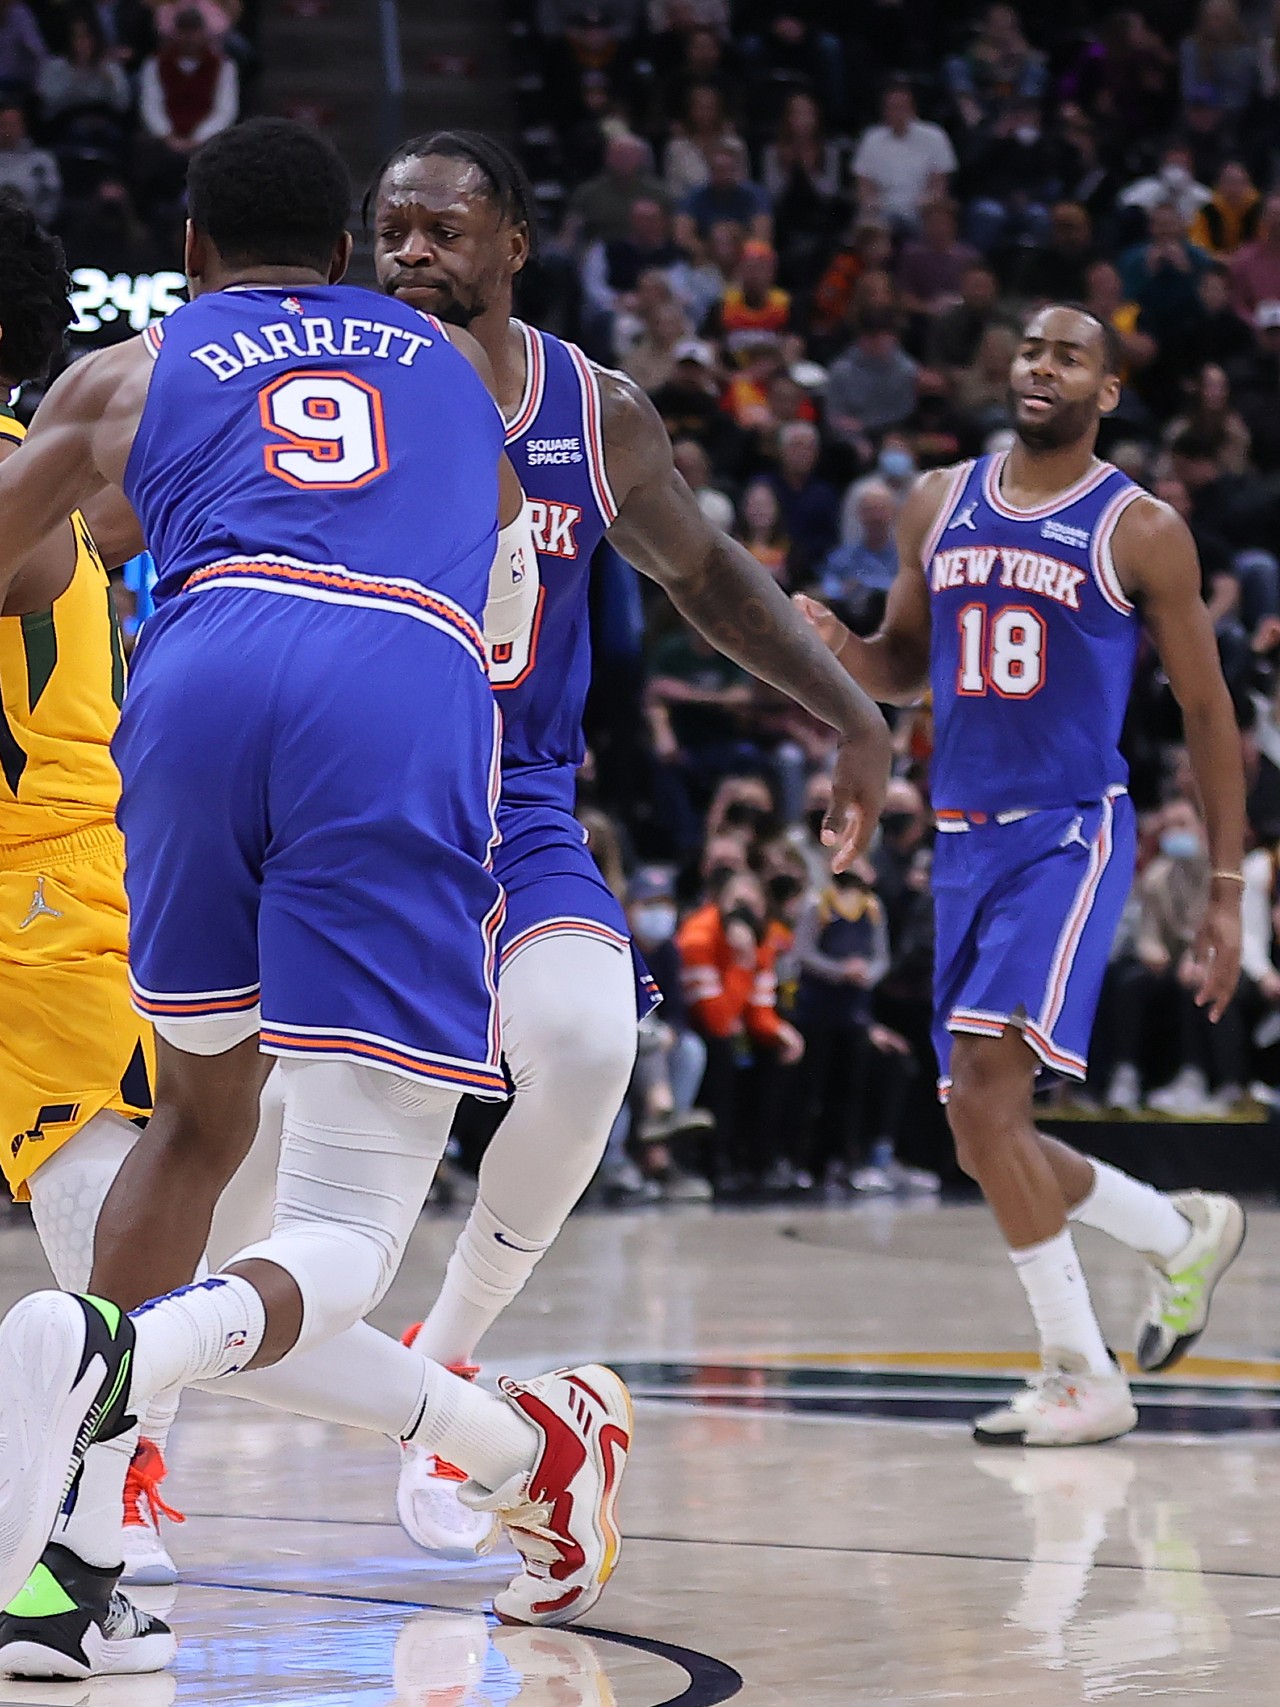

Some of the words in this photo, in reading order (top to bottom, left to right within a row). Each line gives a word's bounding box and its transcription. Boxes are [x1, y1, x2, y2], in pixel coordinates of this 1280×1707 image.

[190, 316, 433, 382] BARRETT
[258, 370, 389, 490] 9
[526, 437, 581, 452] SQUARE
[527, 452, 571, 466] SPACE
[527, 497, 583, 560] RK
[931, 546, 999, 594] NEW
[997, 548, 1087, 611] YORK
[956, 602, 1048, 700] 18
